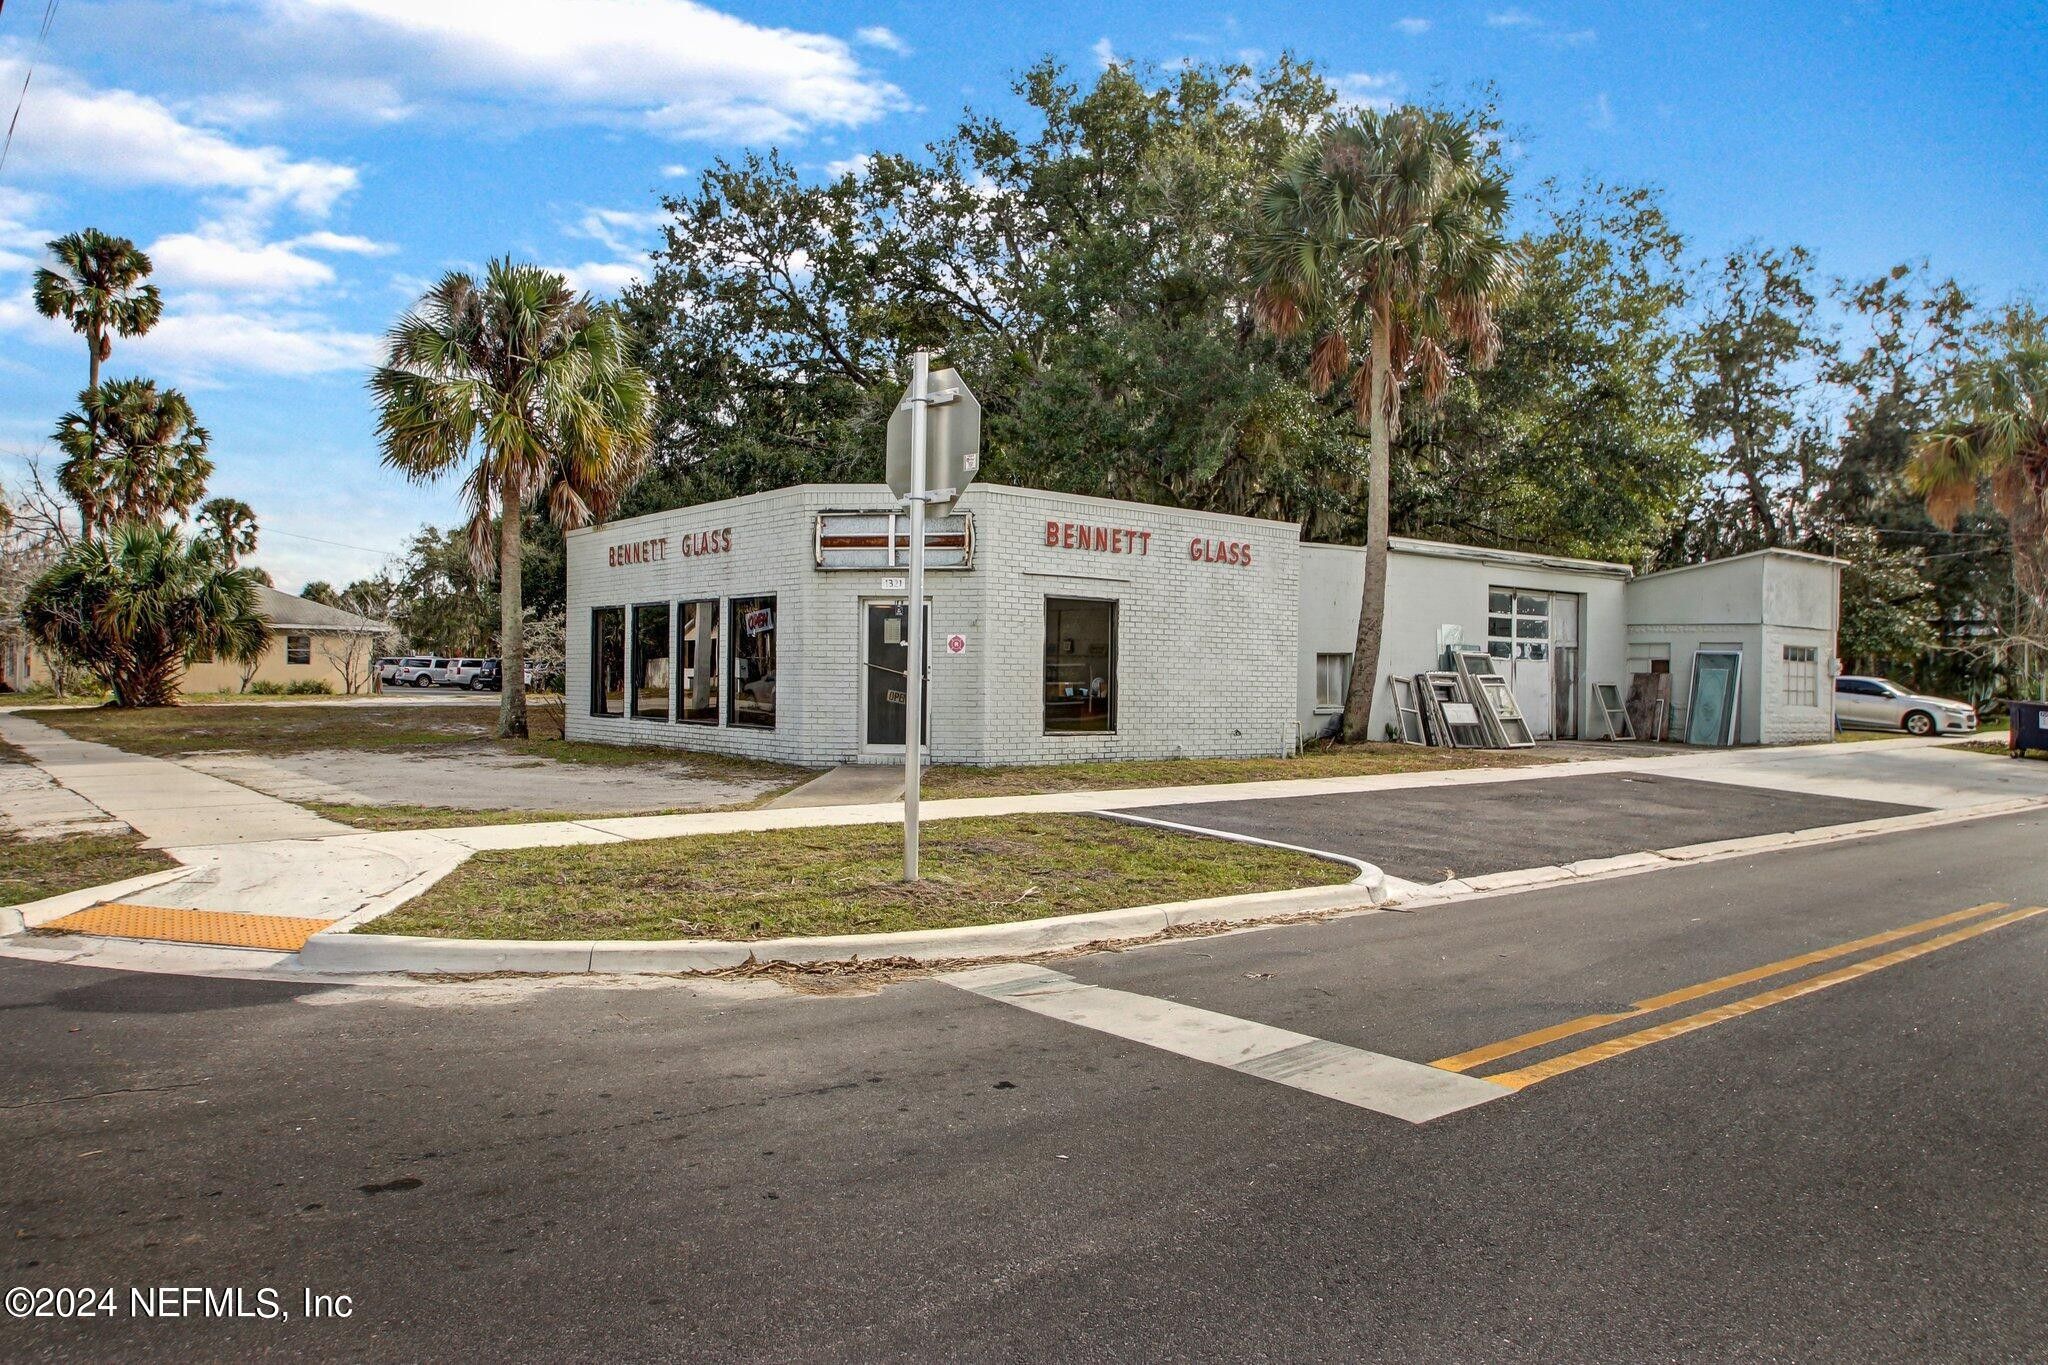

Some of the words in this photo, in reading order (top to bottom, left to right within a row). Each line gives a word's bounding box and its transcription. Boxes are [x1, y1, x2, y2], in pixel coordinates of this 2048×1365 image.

[609, 537, 668, 567] BENNETT
[681, 527, 732, 558] GLASS
[1045, 521, 1151, 556] BENNETT
[1190, 537, 1252, 566] GLASS
